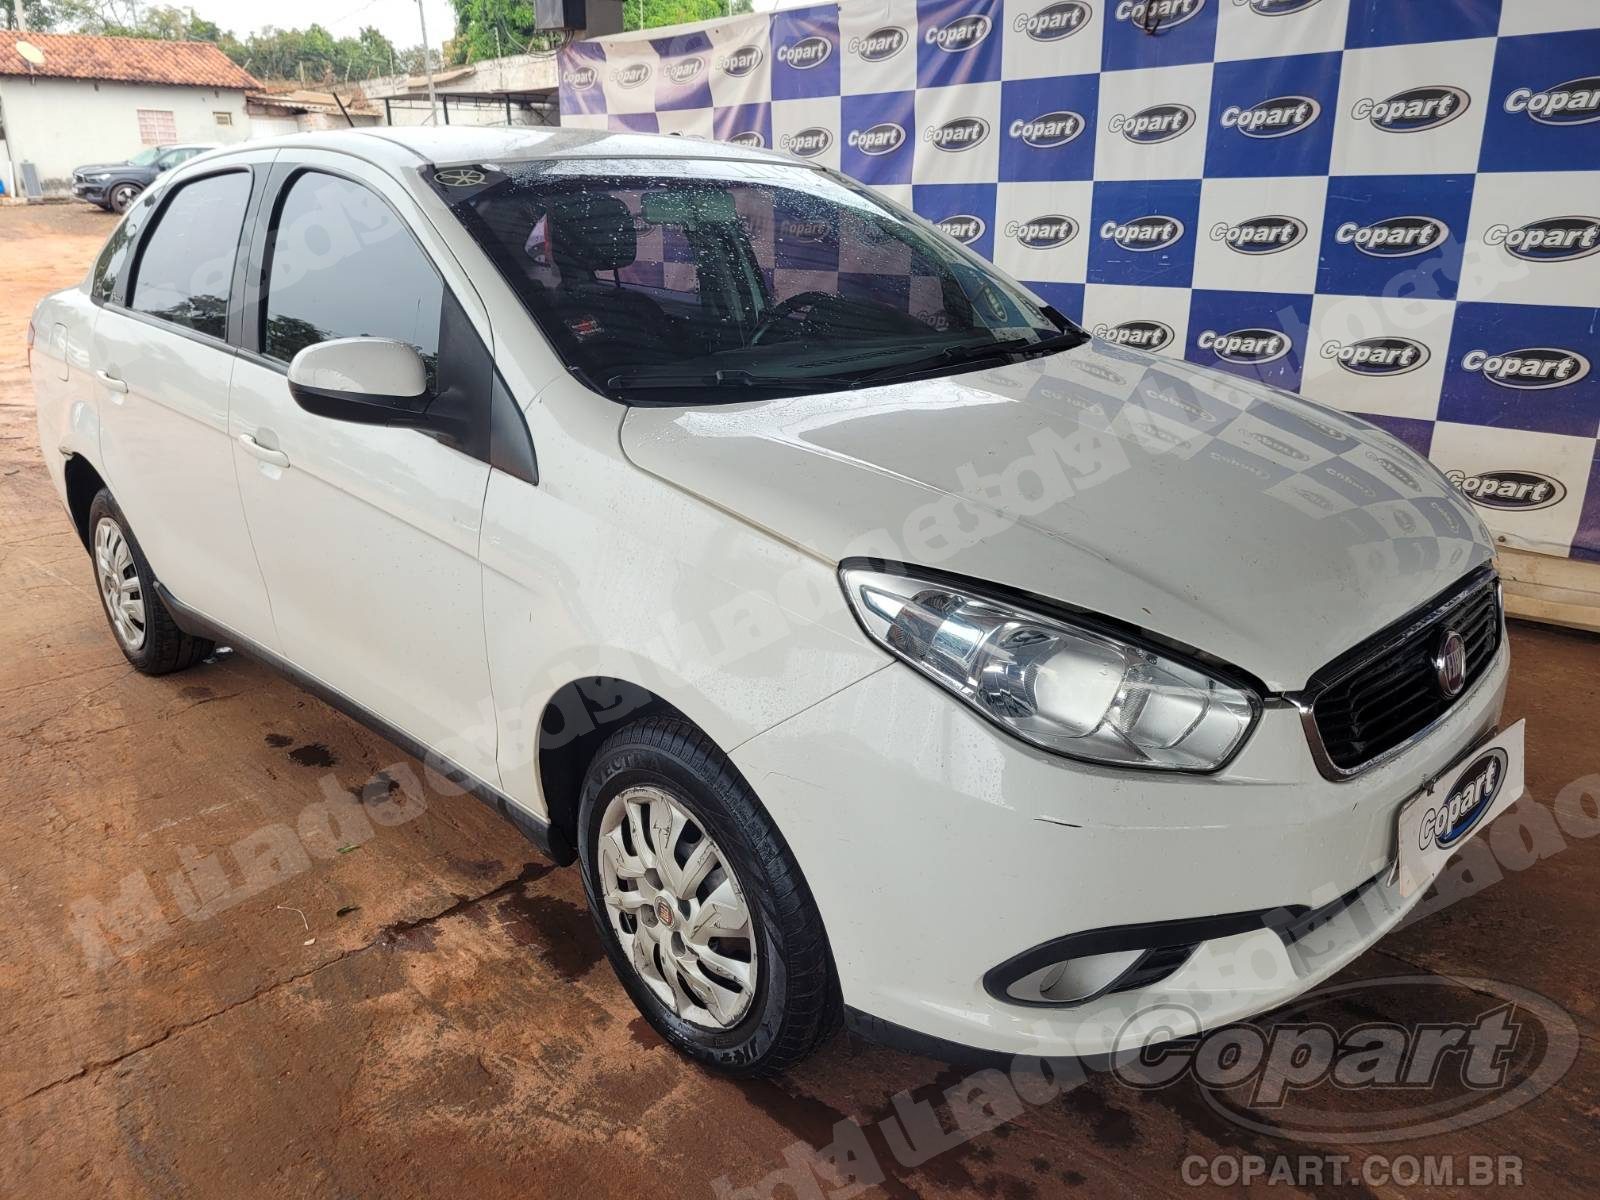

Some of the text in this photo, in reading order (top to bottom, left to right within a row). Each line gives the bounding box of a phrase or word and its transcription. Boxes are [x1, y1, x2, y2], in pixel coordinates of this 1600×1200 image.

[1013, 9, 1080, 32] Copart
[849, 31, 900, 55] Copart
[925, 22, 983, 46] Copart
[715, 50, 758, 71] Copart
[778, 43, 824, 62] Copart
[563, 69, 595, 85] Copart
[609, 66, 646, 82] Copart
[663, 60, 700, 79] Copart
[1351, 94, 1453, 123] Copart
[1504, 88, 1600, 117] Copar
[1108, 111, 1184, 134] Copart
[1221, 103, 1308, 129] Copart
[849, 128, 897, 149] Copart
[924, 122, 980, 142] Copart
[1010, 117, 1074, 139] Copart
[780, 132, 824, 153] Copart
[1004, 220, 1068, 242] Copart
[1102, 221, 1174, 242] Copart
[1209, 222, 1294, 245] Copart
[1336, 222, 1435, 247] Copart
[1483, 223, 1599, 252] Copart
[1093, 323, 1162, 345] Copart
[1198, 330, 1280, 356] Copart
[1320, 340, 1414, 367] Copart
[1461, 349, 1574, 380] Copart
[1419, 758, 1498, 850] Copart
